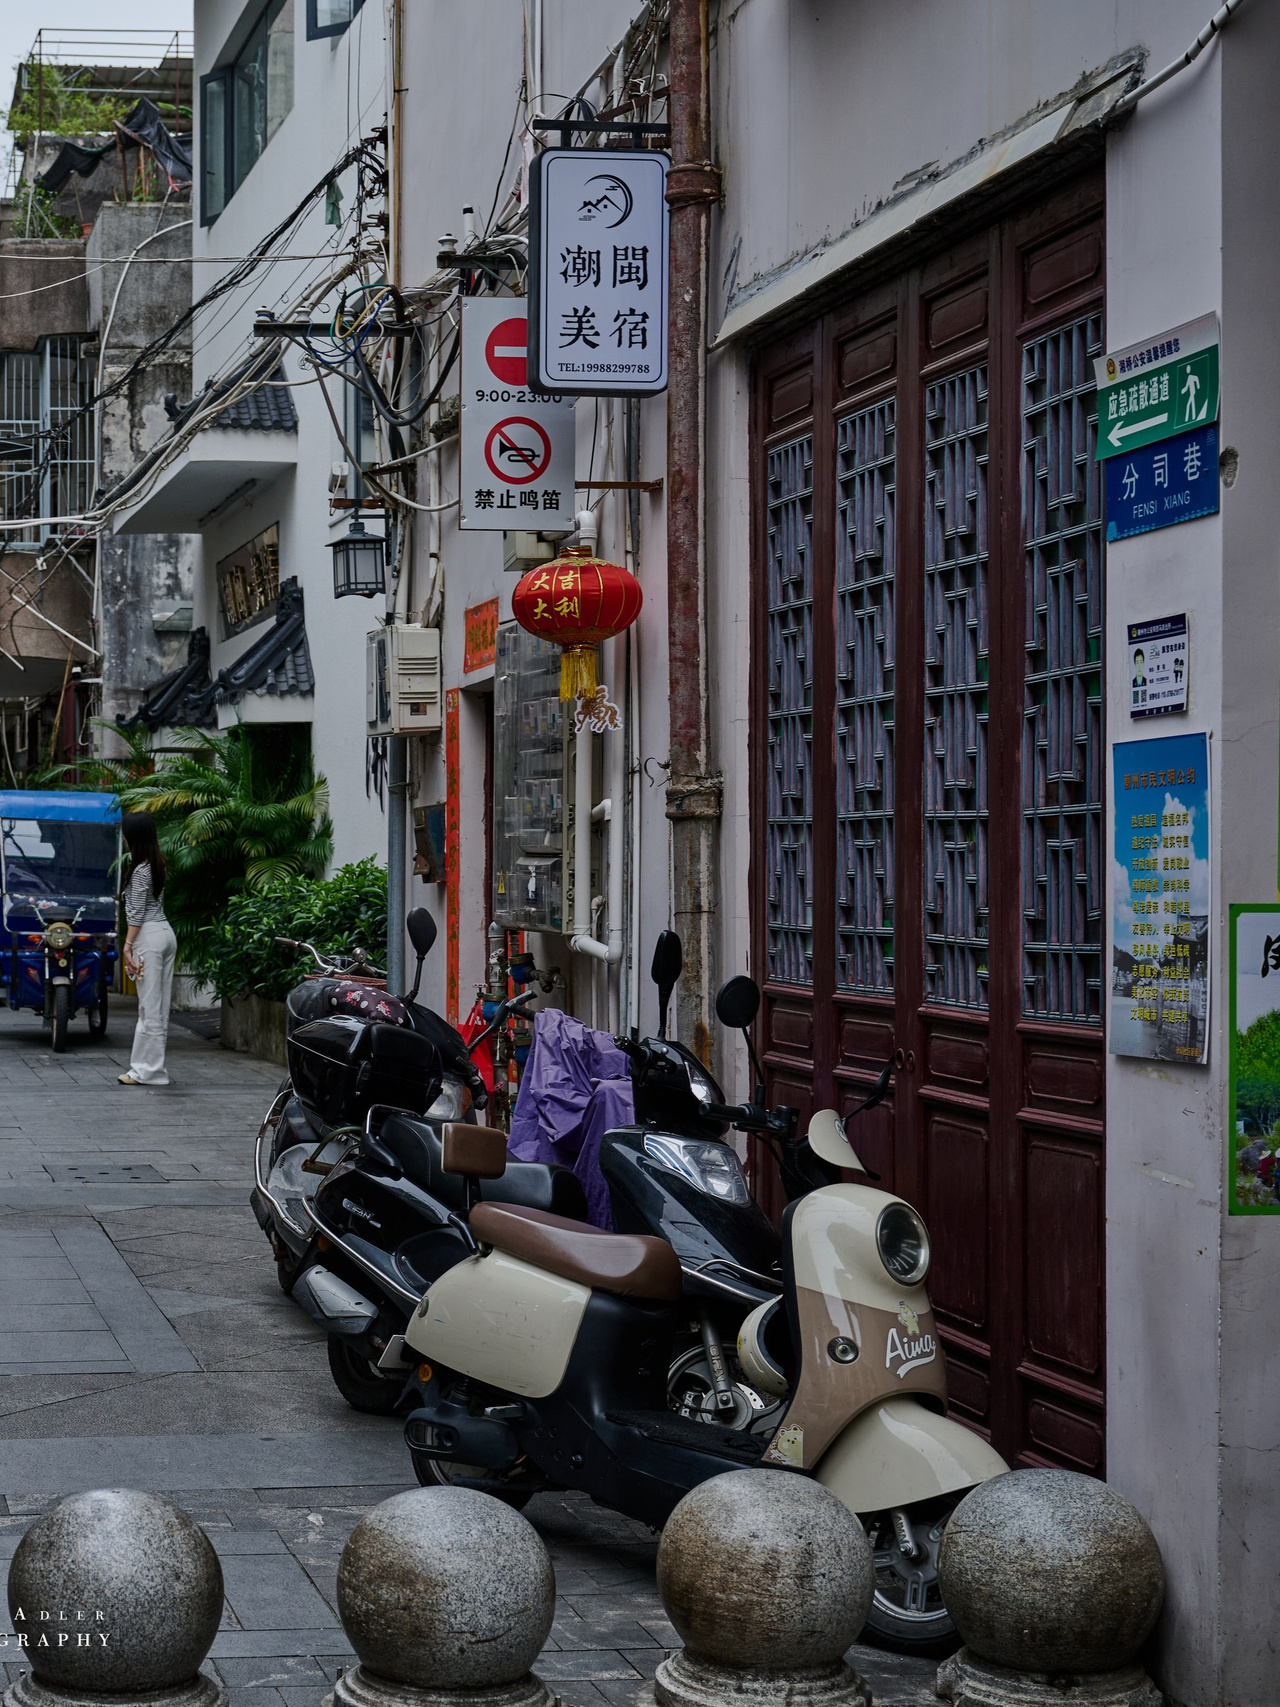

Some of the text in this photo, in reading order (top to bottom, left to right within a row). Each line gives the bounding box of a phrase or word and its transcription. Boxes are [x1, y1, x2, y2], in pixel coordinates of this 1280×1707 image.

[558, 305, 650, 350] 美宿
[557, 362, 651, 375] TEL:19988299788
[1118, 337, 1181, 374] 湘桥公安温馨提醒您
[475, 389, 563, 404] 9:00-23:00
[1107, 372, 1170, 421] 应急疏散通道
[1121, 441, 1202, 501] 分司巷
[474, 487, 562, 513] 禁止鸣笛
[1132, 490, 1191, 519] FENSI XIANG
[531, 570, 579, 591] 大吉
[533, 596, 580, 620] 大利
